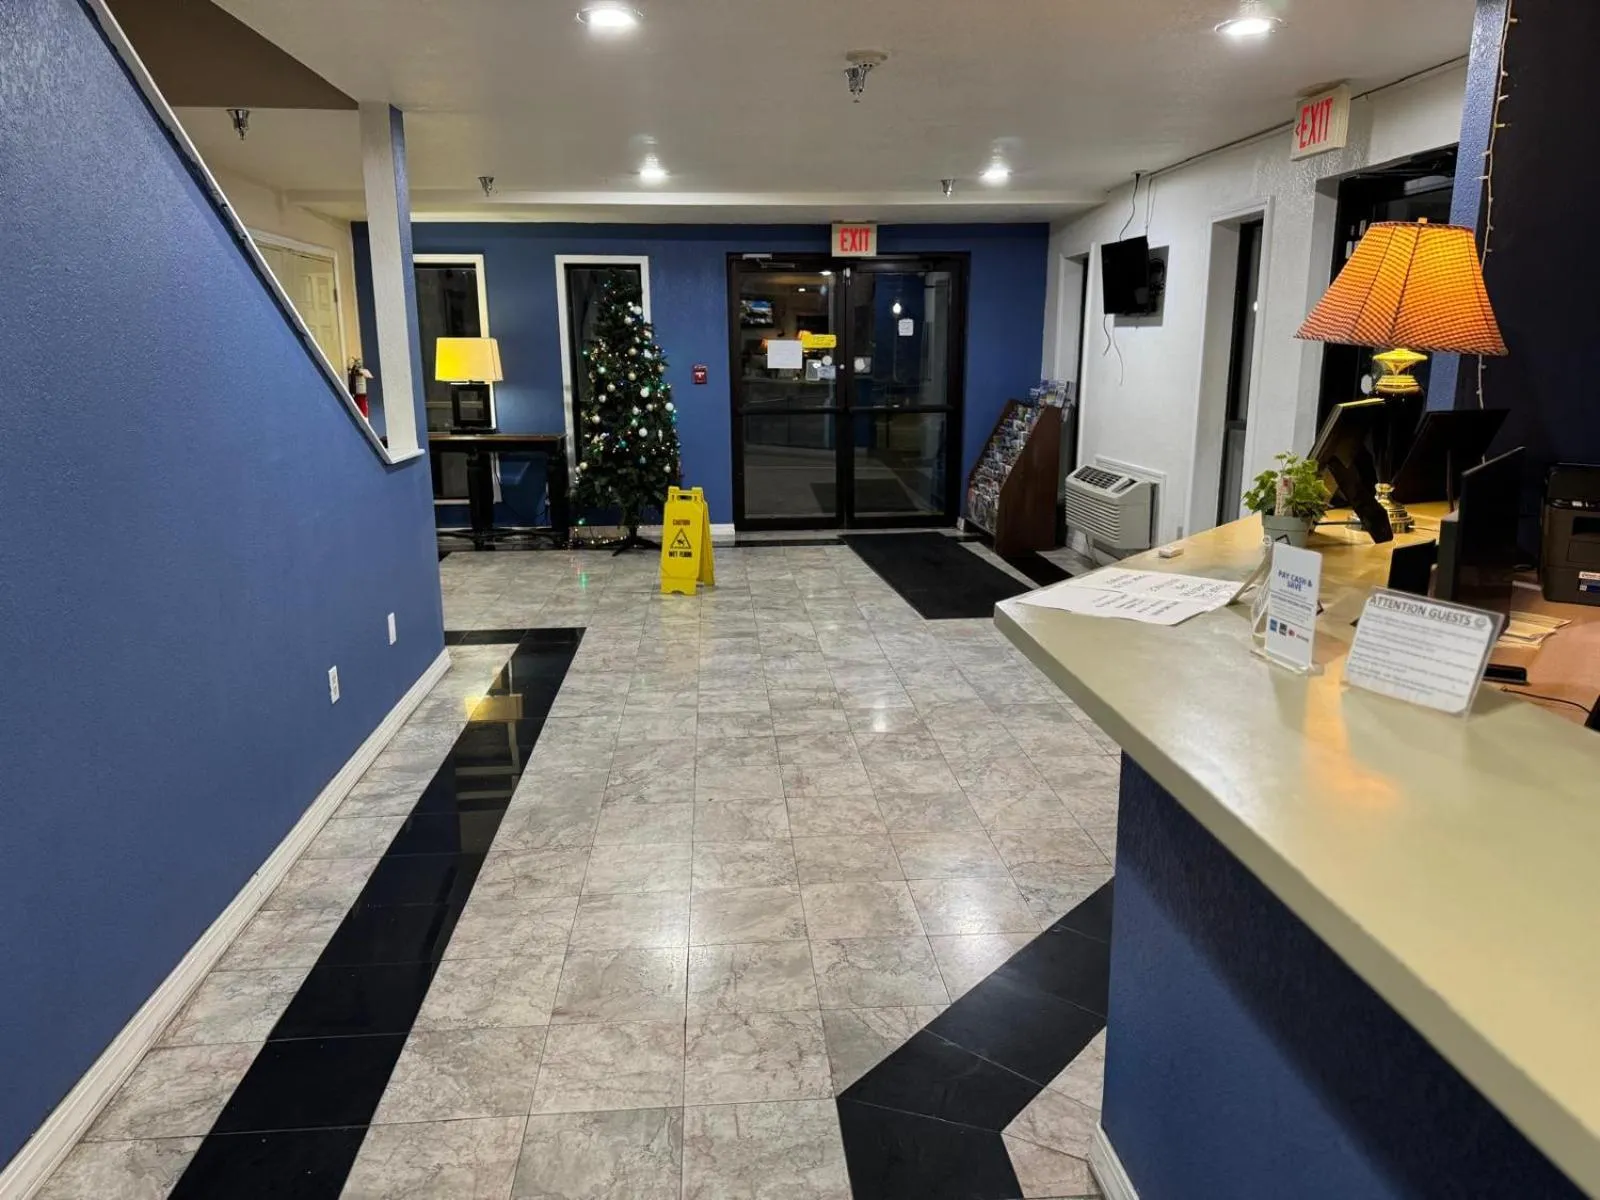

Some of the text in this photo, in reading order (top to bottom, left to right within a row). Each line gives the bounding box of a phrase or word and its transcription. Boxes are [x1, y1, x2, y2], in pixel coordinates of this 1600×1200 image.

[1299, 97, 1333, 149] EXIT
[840, 227, 871, 252] EXIT
[1278, 570, 1290, 580] PAY
[1290, 574, 1307, 585] CASH
[1287, 580, 1302, 591] SAVE
[1368, 596, 1471, 625] ATTENTION GUESTS
